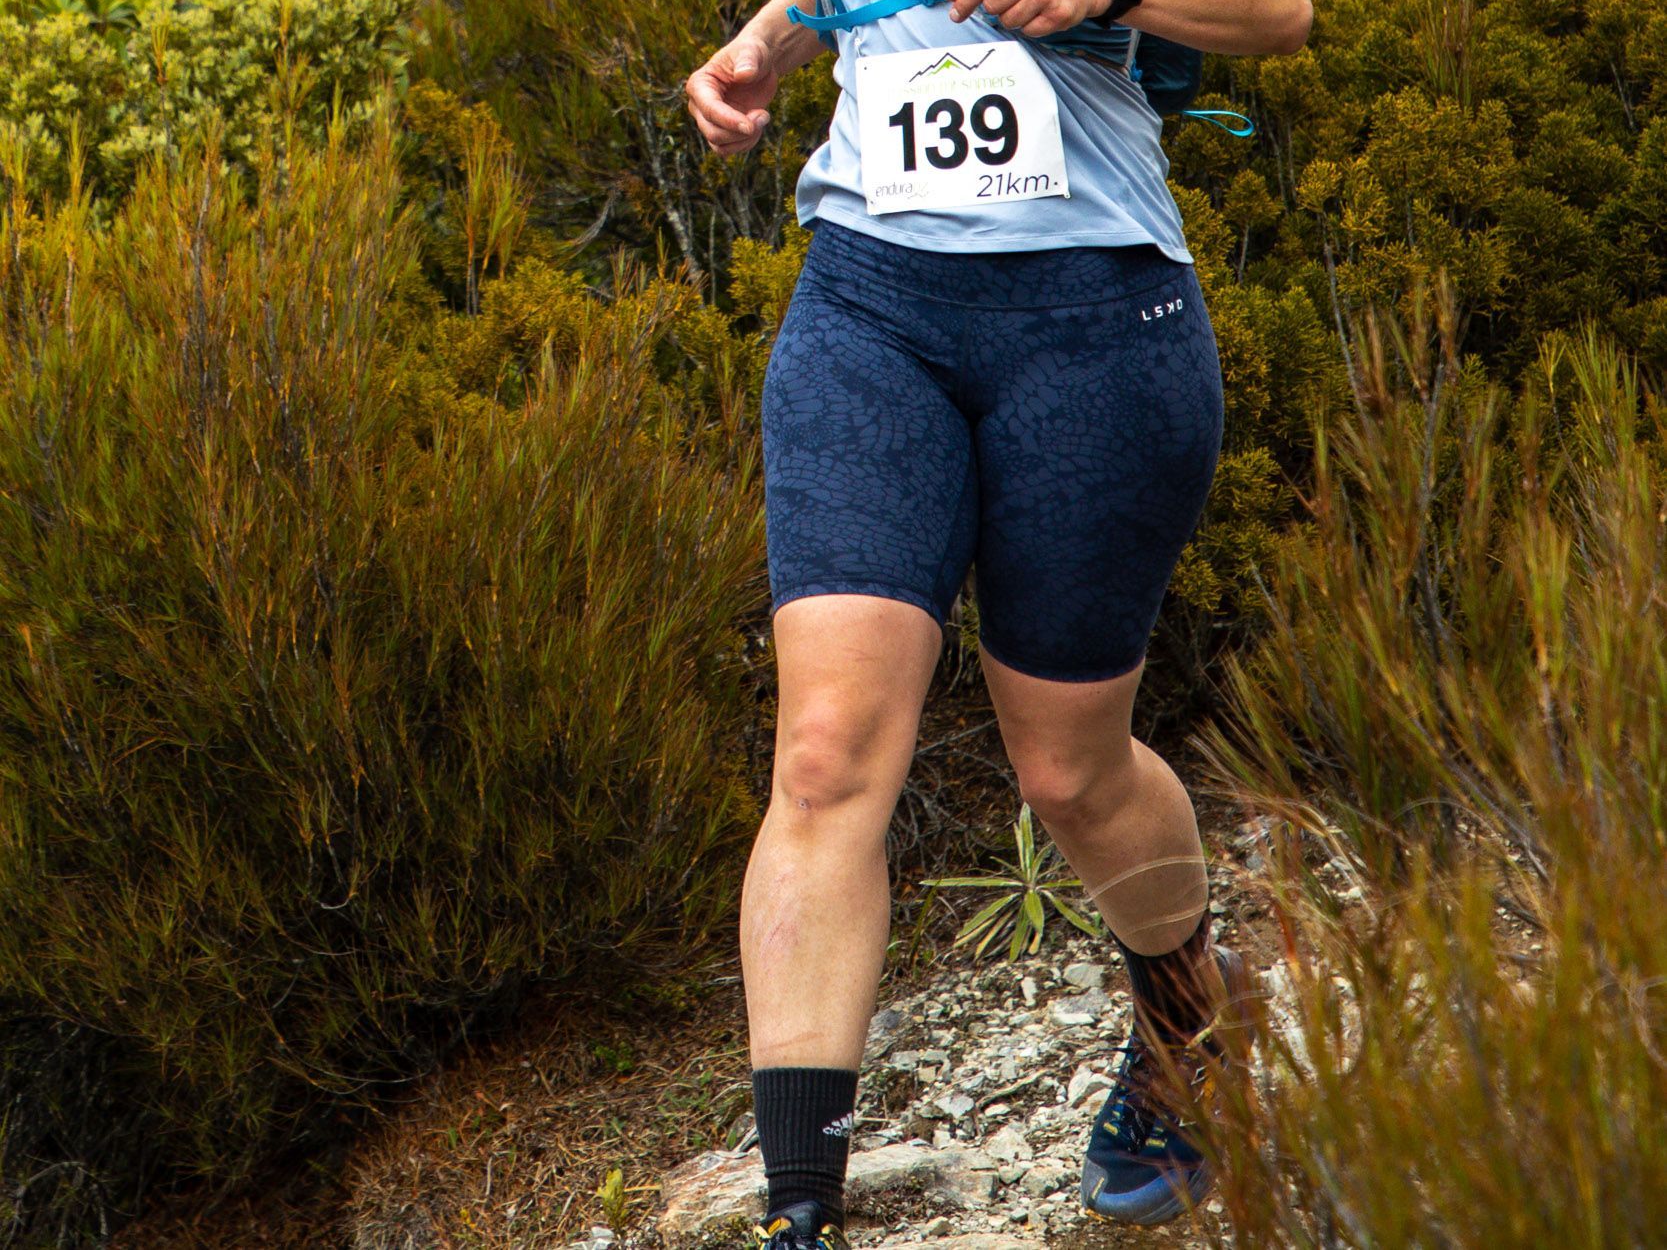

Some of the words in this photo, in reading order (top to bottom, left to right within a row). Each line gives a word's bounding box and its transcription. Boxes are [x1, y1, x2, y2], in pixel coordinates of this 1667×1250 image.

[888, 93, 1019, 172] 139
[976, 172, 1050, 198] 21km
[1141, 298, 1183, 321] LSKD
